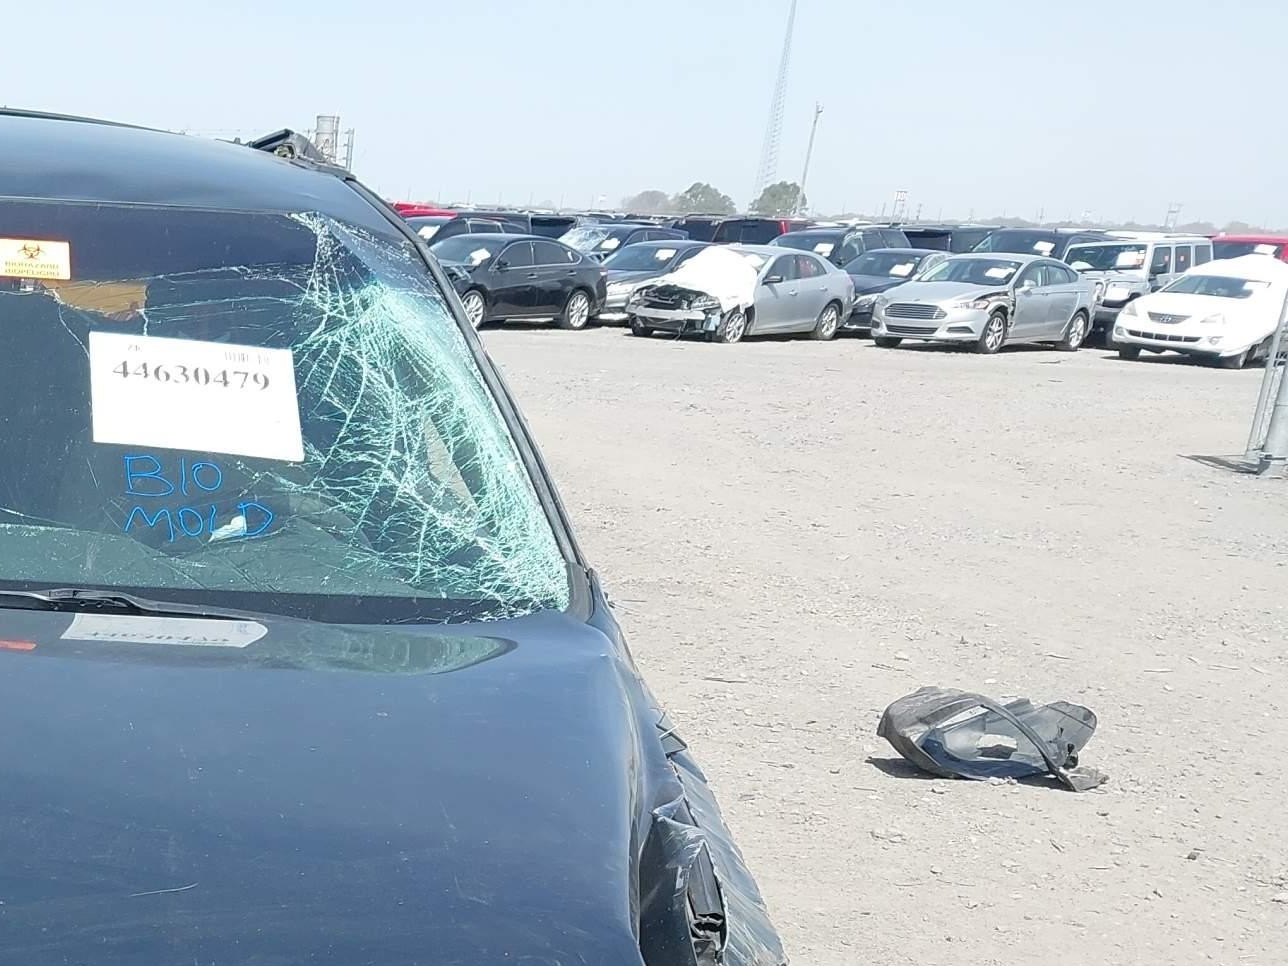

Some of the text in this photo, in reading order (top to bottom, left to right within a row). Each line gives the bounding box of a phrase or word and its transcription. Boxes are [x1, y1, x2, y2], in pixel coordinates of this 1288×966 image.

[112, 360, 271, 391] 44630479
[124, 455, 223, 497] BIO
[124, 502, 274, 543] MOLD
